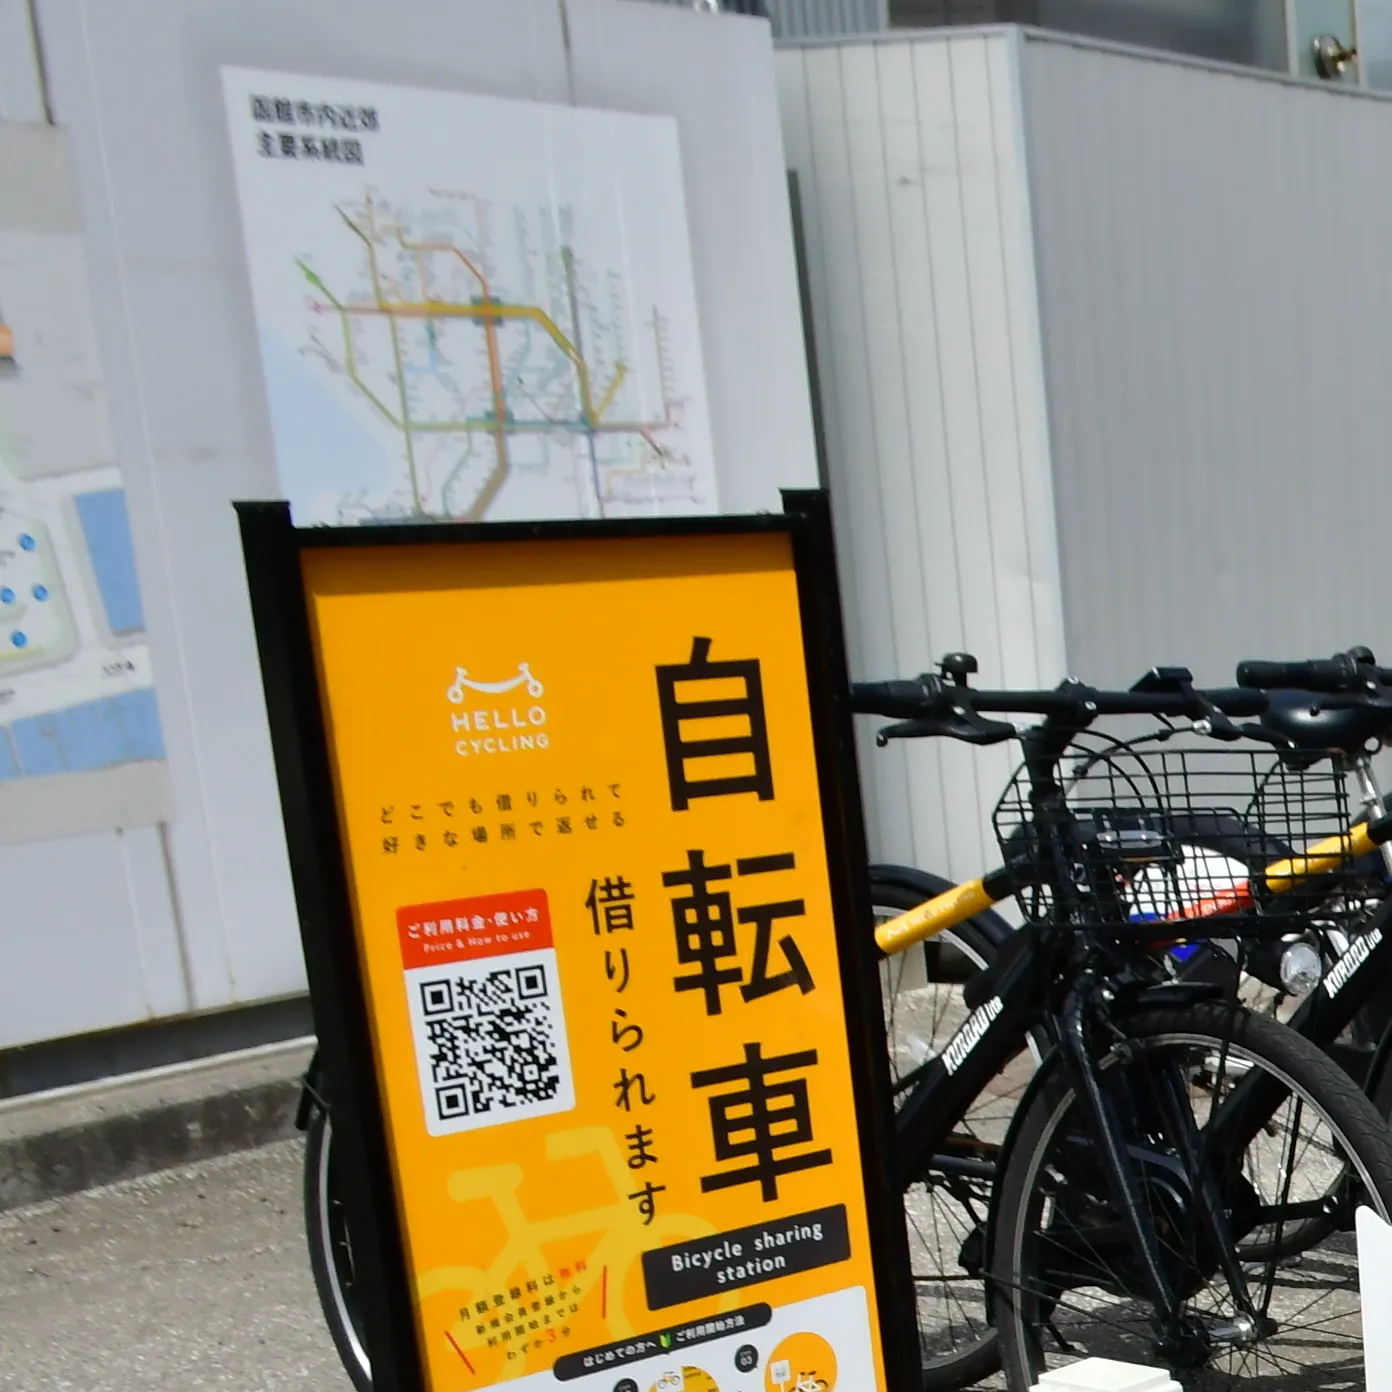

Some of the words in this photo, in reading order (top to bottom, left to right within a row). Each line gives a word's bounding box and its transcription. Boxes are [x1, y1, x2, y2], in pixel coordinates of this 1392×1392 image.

[250, 94, 380, 132] 函館市内近郊
[257, 130, 365, 167] 主要系統図
[450, 705, 547, 732] HELLO
[455, 732, 550, 756] CYCLING
[380, 783, 622, 825] どこでも借りられて
[382, 811, 625, 854] 好きな場所で返せる
[407, 907, 540, 939] ご利用料金・使い方
[655, 636, 833, 1203] 自転車
[422, 941, 453, 954] Price
[456, 936, 465, 949] &
[467, 933, 494, 948] How
[496, 931, 509, 944] to
[512, 929, 531, 942] use
[585, 876, 667, 1226] 借りられます
[671, 1241, 743, 1272] Bicycle
[754, 1222, 824, 1252] sharing
[716, 1254, 787, 1284] station
[582, 1340, 657, 1368] はじめての方へ
[675, 1314, 746, 1343] ご利用開始方法
